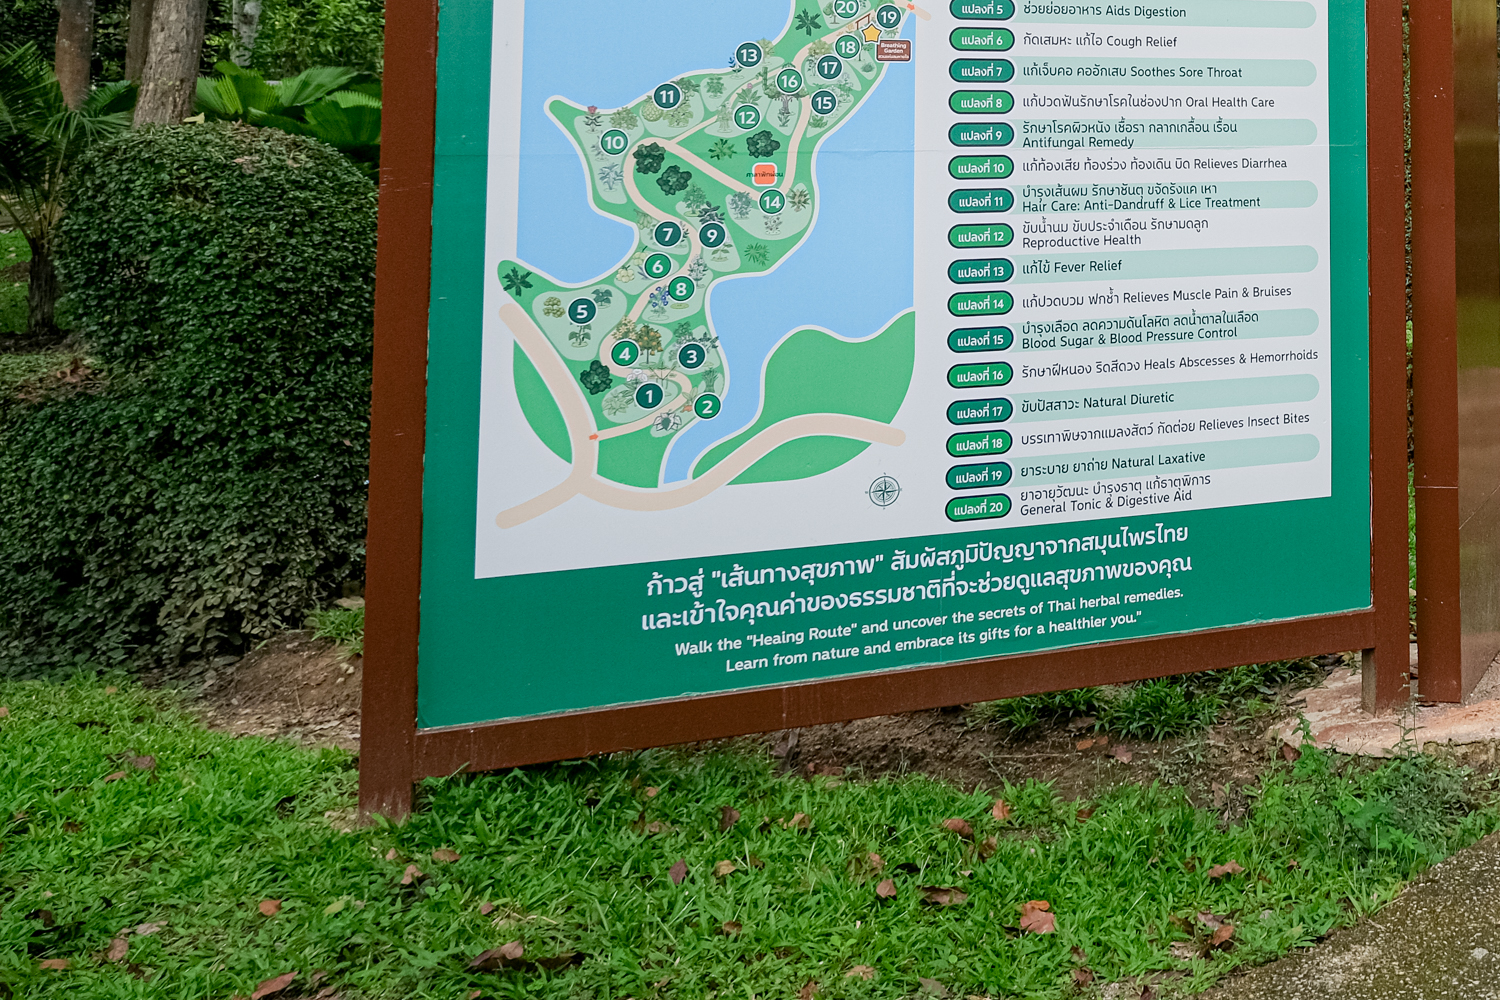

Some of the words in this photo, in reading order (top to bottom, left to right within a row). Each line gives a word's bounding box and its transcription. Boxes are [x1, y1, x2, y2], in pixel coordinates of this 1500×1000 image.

[836, 0, 856, 13] 20
[1023, 0, 1102, 16] ช่วยย่อยอาหาร
[1105, 4, 1131, 16] Aids
[1134, 5, 1186, 19] Digestion
[880, 11, 897, 23] 19
[1023, 32, 1072, 46] กัดเสมหะ
[1075, 31, 1103, 46] แก้ไอ
[1106, 35, 1142, 49] Cough
[1145, 36, 1177, 47] Relief
[839, 41, 856, 54] 18
[740, 48, 757, 62] 13
[821, 61, 838, 74] 17
[1023, 61, 1073, 76] แก้เจ็บคอ
[1076, 63, 1127, 77] คออักเสบ
[1130, 65, 1175, 77] Soothes
[1179, 66, 1203, 77] Sore
[1206, 66, 1242, 77] Throat
[781, 75, 798, 88] 16
[659, 90, 673, 103] 11
[815, 96, 832, 109] 15
[1185, 96, 1208, 108] Oral
[1211, 96, 1247, 107] Health
[1251, 96, 1275, 107] Care
[738, 111, 756, 124] 12
[604, 135, 624, 149] 10
[1022, 136, 1085, 150] Antifungal
[1088, 136, 1134, 150] Remedy
[959, 159, 990, 173] แปลงที่
[992, 163, 1004, 173] 10
[1022, 157, 1080, 171] แก้ท้องเสีย
[1084, 156, 1127, 171] ท้องร่วง
[1130, 156, 1172, 170] ท้องเดิน
[1175, 157, 1190, 169] บิด
[1194, 158, 1238, 169] Relieves
[1241, 157, 1287, 168] Diarrhea
[763, 195, 781, 209] 14
[1022, 200, 1047, 212] Hair
[1051, 200, 1080, 211] Care:
[1083, 197, 1164, 211] Anti-Dandruff
[1167, 197, 1176, 209] &
[1179, 197, 1201, 209] Lice
[1204, 197, 1260, 208] Treatment
[662, 228, 673, 241] 7
[706, 229, 717, 242] 9
[1022, 235, 1100, 250] Reproductive
[1103, 233, 1141, 246] Health
[652, 260, 663, 273] 6
[1022, 259, 1050, 274] แก้ไข้
[1054, 261, 1086, 273] Fever
[1089, 259, 1122, 272] Relief
[675, 282, 687, 296] 8
[1022, 293, 1084, 308] แก้ปวดบวม
[1088, 286, 1119, 305] ฟกช้ำ
[1123, 291, 1169, 303] Relieves
[1172, 288, 1211, 301] Muscle
[1214, 287, 1238, 299] Pain
[1241, 286, 1249, 298] &
[1253, 285, 1291, 298] Bruises
[576, 304, 587, 318] 5
[1022, 319, 1078, 338] บำรุงเลือด
[1022, 336, 1056, 349] Blood
[1060, 335, 1094, 349] Sugar
[1097, 333, 1106, 345] &
[1110, 331, 1143, 344] Blood
[1146, 330, 1194, 342] Pressure
[1197, 326, 1237, 339] Control
[618, 347, 630, 360] 4
[686, 349, 697, 363] 3
[1021, 362, 1092, 378] รักษาฝีหนอง
[1095, 359, 1140, 374] ริดสีดวง
[1144, 357, 1176, 370] Heals
[1178, 356, 1235, 368] Abscesses
[1238, 353, 1247, 364] &
[1250, 349, 1318, 363] Hemorrhoids
[646, 390, 652, 403] 1
[1021, 398, 1079, 413] ขับปัสสาวะ
[1083, 394, 1127, 408] Natural
[1130, 391, 1174, 405] Diuretic
[702, 400, 712, 414] 2
[1157, 419, 1195, 434] กัดต่อย
[1199, 418, 1244, 431] Relieves
[1247, 414, 1280, 427] Insect
[1283, 412, 1310, 424] Bites
[1020, 463, 1069, 477] ยาระบาย
[1072, 457, 1108, 473] ยาถ่าย
[1111, 454, 1155, 469] Natural
[1158, 451, 1206, 465] Laxative
[1020, 500, 1066, 516] General
[1070, 498, 1101, 511] Tonic
[1105, 496, 1113, 508] &
[1117, 492, 1170, 509] Digestive
[1173, 489, 1192, 502] Aid
[646, 567, 705, 598] ก้าวสู่
[674, 639, 712, 656] Walk
[716, 637, 742, 651] the
[746, 630, 804, 647] "Heaing
[808, 622, 857, 641] Route"
[861, 619, 889, 634] and
[892, 615, 948, 631] uncover
[951, 610, 974, 623] the
[978, 605, 1026, 621] secrets
[1029, 601, 1044, 615] of
[1047, 597, 1076, 612] Thai
[1079, 592, 1120, 609] herbal
[1124, 587, 1183, 604] remedies.
[726, 657, 768, 672] Learn
[772, 652, 808, 666] from
[811, 646, 859, 661] nature
[863, 640, 891, 655] and
[894, 635, 954, 651] embrace
[958, 631, 975, 644] its
[978, 627, 1010, 644] gifts
[1013, 624, 1033, 637] for
[1036, 624, 1045, 634] a
[1048, 615, 1107, 633] healthier
[1110, 610, 1142, 628] you."
